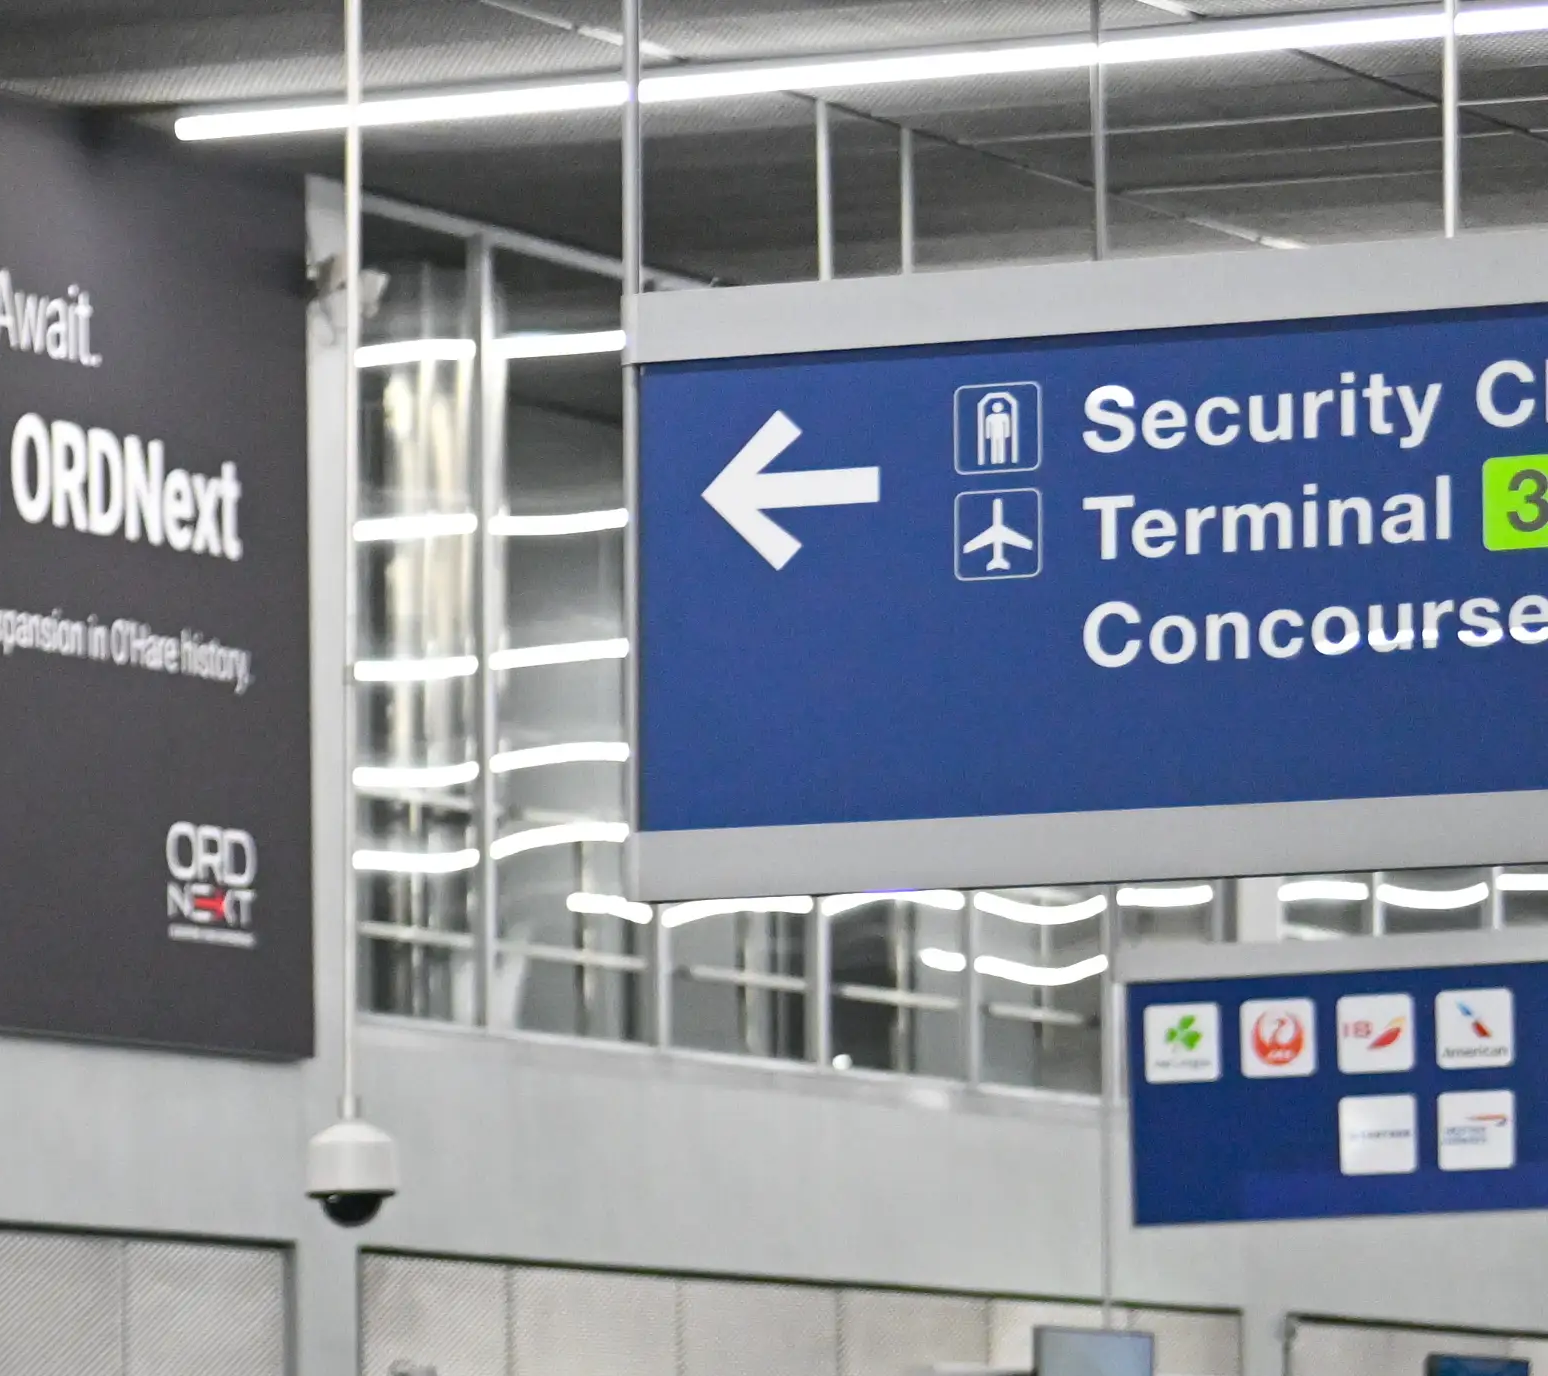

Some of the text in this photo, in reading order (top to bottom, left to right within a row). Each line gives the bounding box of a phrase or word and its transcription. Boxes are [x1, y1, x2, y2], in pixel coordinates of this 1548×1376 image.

[1082, 358, 1548, 454] Security C
[10, 411, 243, 561] ORDNext
[1082, 468, 1548, 561] Terminal 3
[87, 614, 108, 662] in
[110, 617, 179, 674] O'Hare
[180, 627, 254, 695] history.
[1082, 594, 1548, 668] Concourse
[166, 821, 256, 887] ORD
